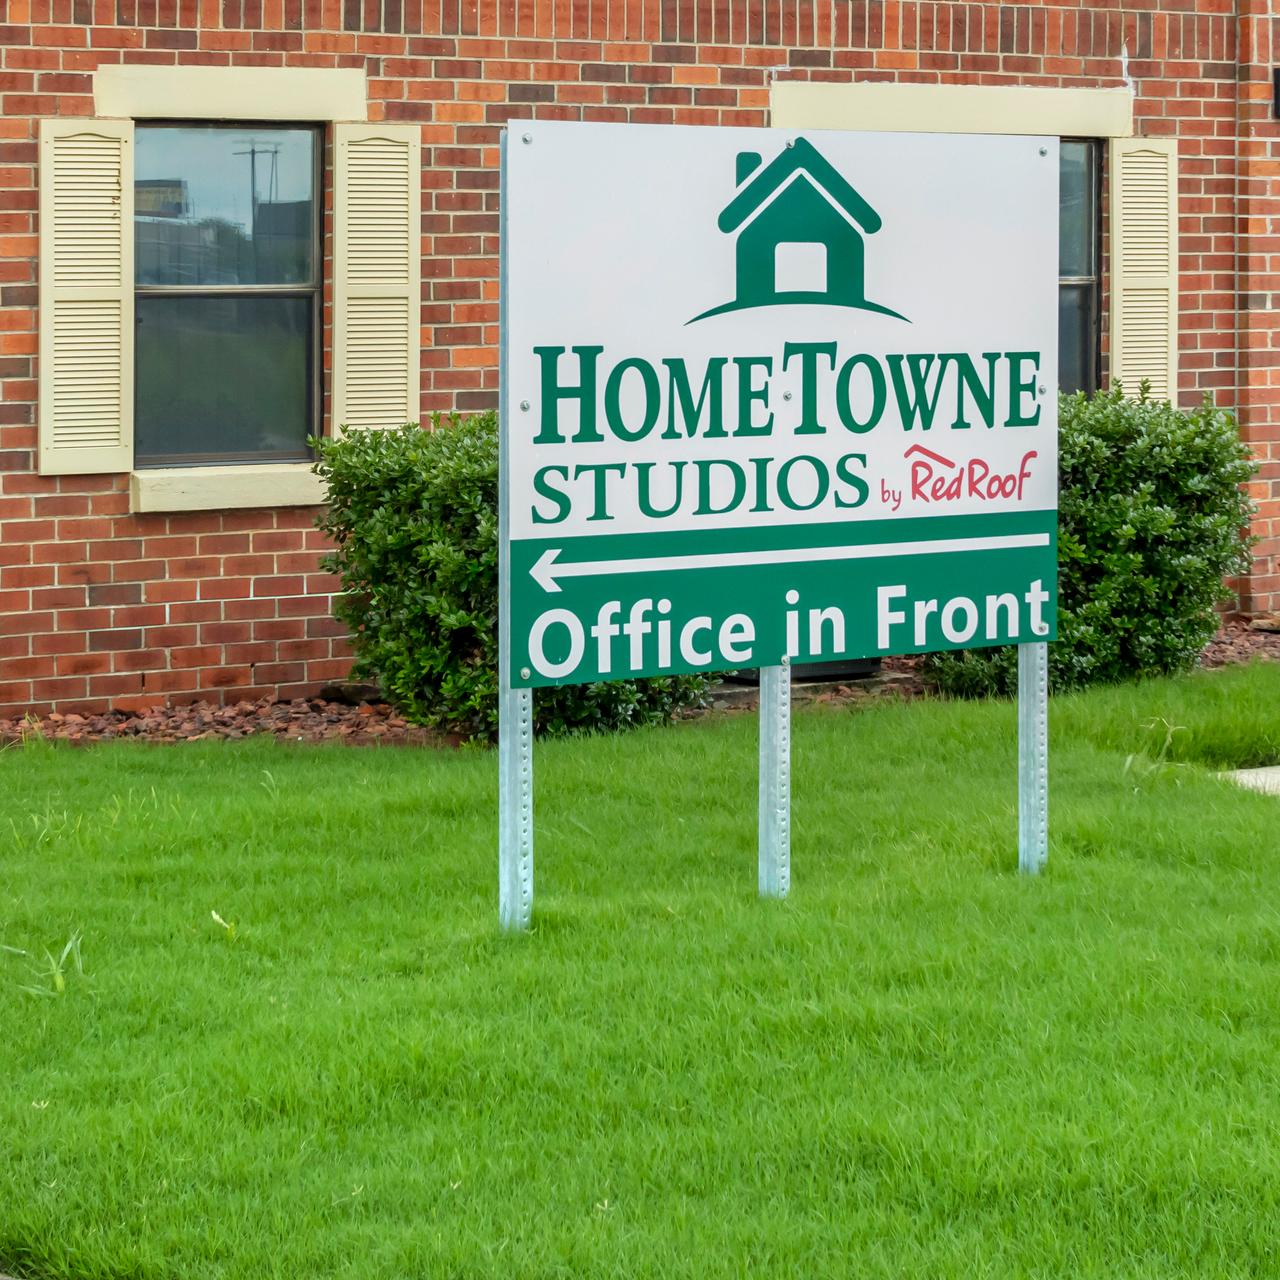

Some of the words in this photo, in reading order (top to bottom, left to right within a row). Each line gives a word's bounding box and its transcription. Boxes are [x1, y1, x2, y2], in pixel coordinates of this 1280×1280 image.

[530, 452, 870, 525] STUDIOS
[880, 478, 902, 512] by
[527, 598, 756, 678] Office
[782, 589, 846, 658] in
[877, 579, 1050, 649] Front
